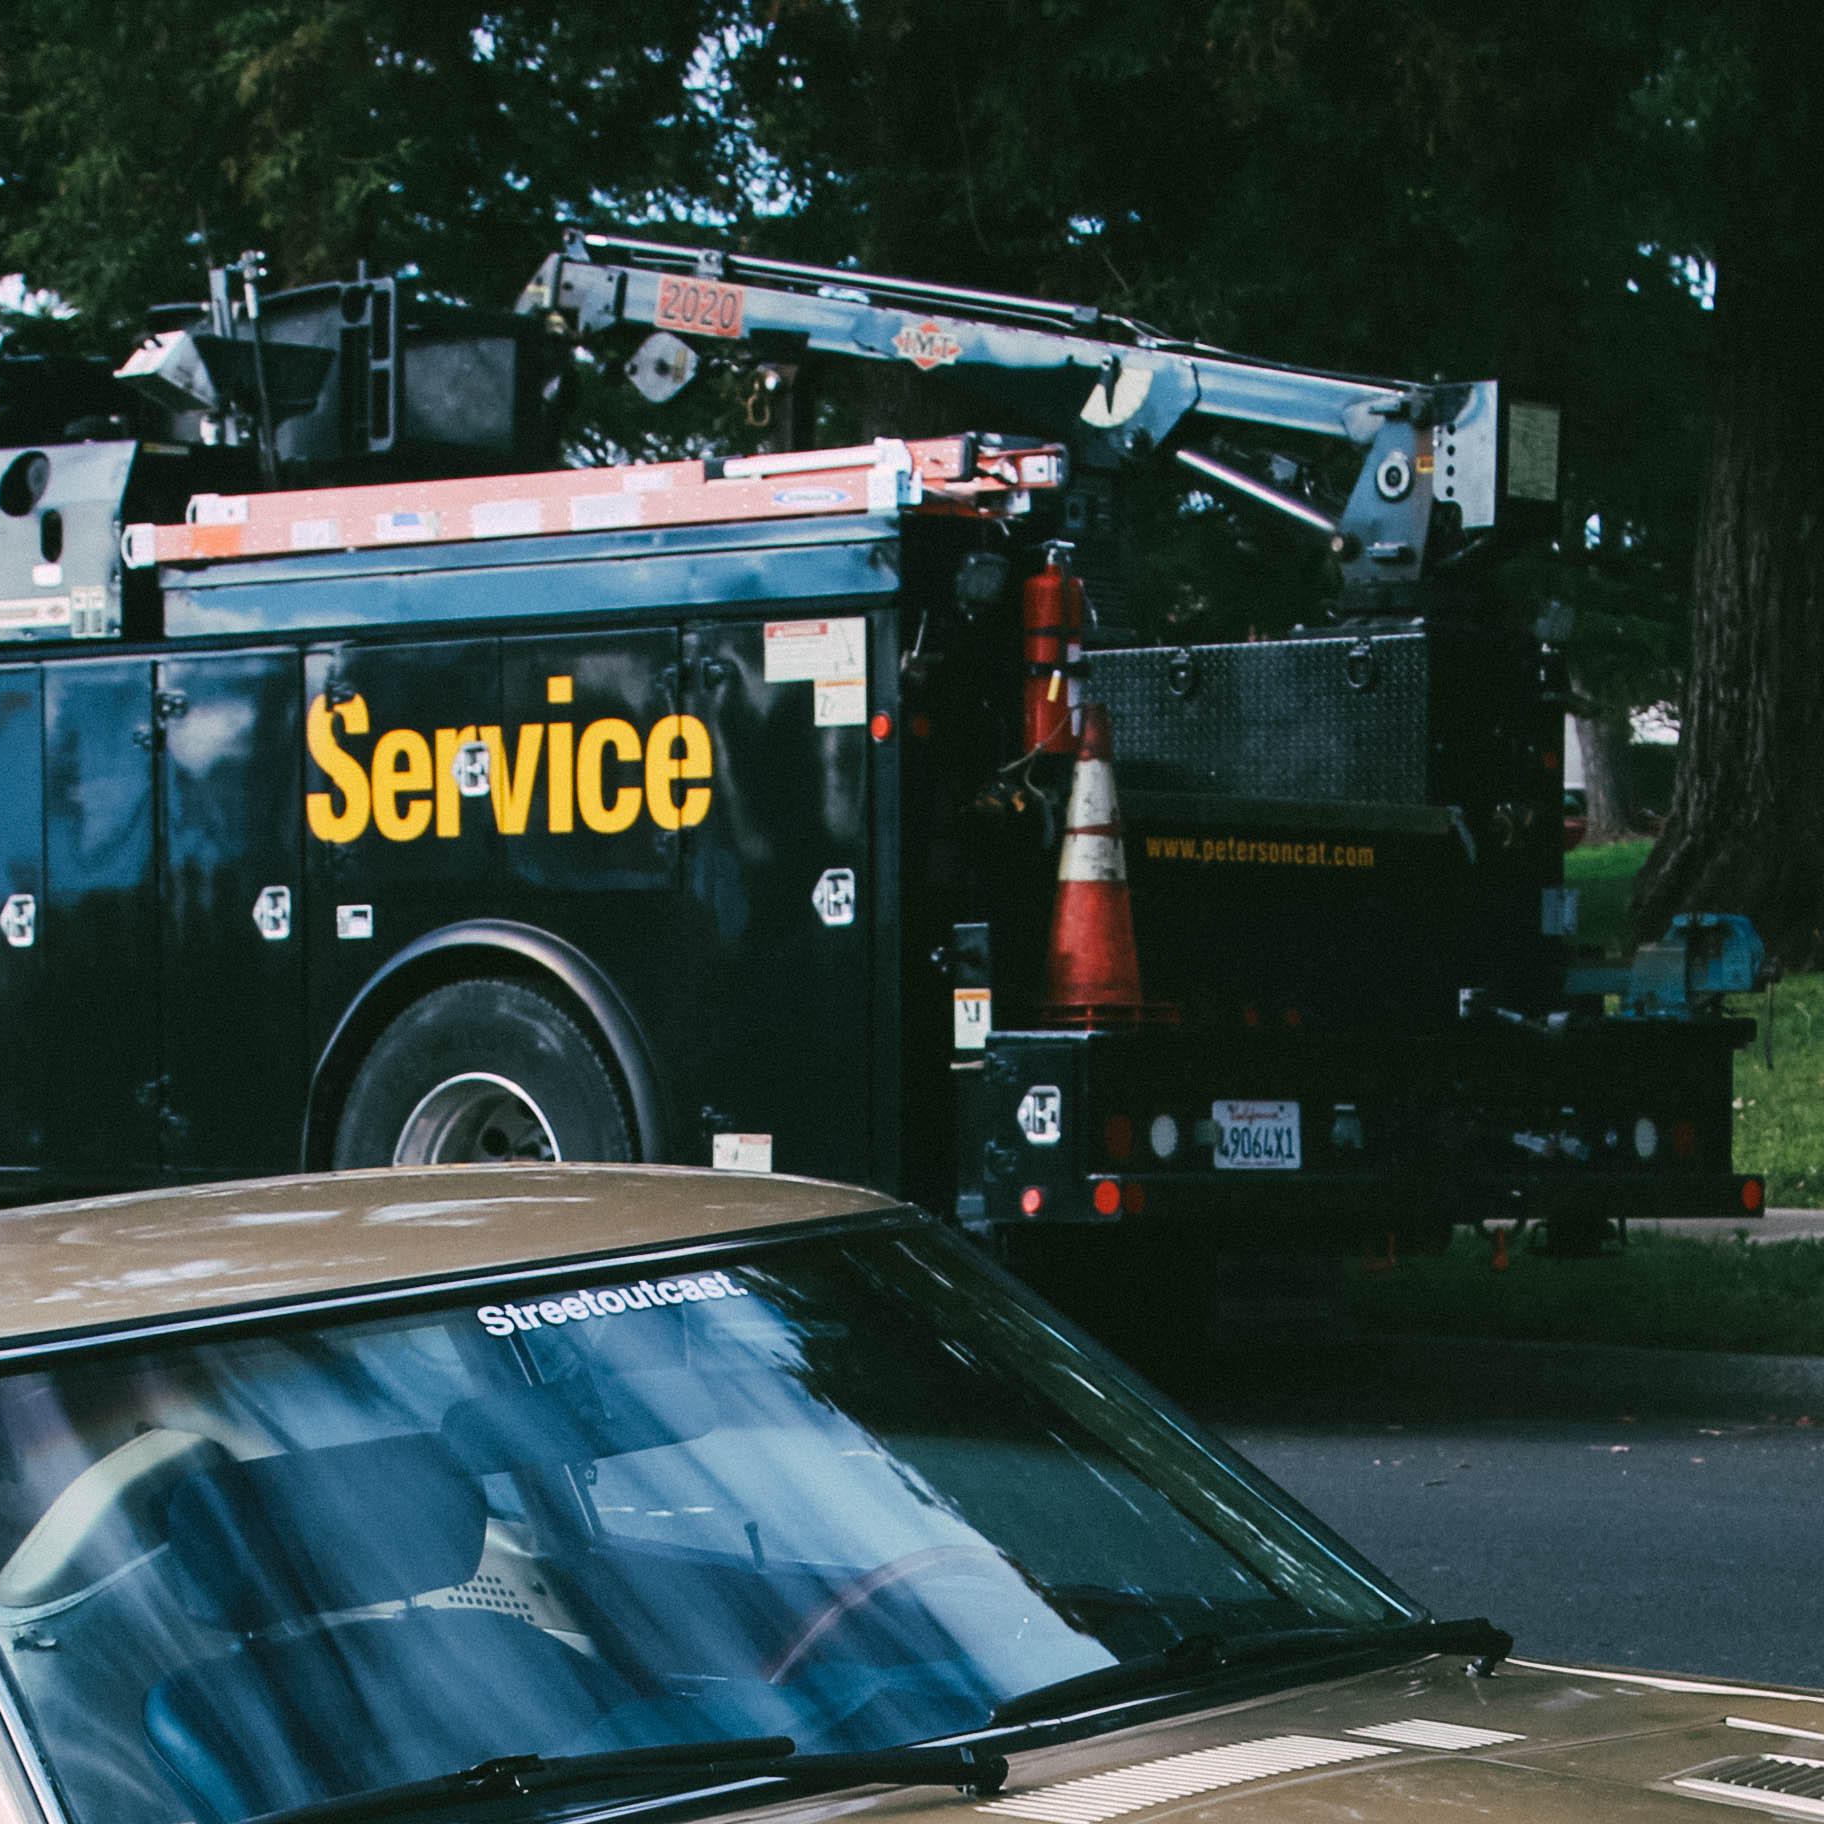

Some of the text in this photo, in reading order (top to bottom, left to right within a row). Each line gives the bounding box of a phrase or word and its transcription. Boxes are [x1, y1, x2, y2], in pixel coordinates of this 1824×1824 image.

[661, 284, 738, 330] 2020
[902, 330, 957, 360] IMT
[306, 675, 713, 844] Service
[1146, 836, 1375, 867] www.petersoncat.com
[476, 1271, 749, 1337] Streetoutcast.
